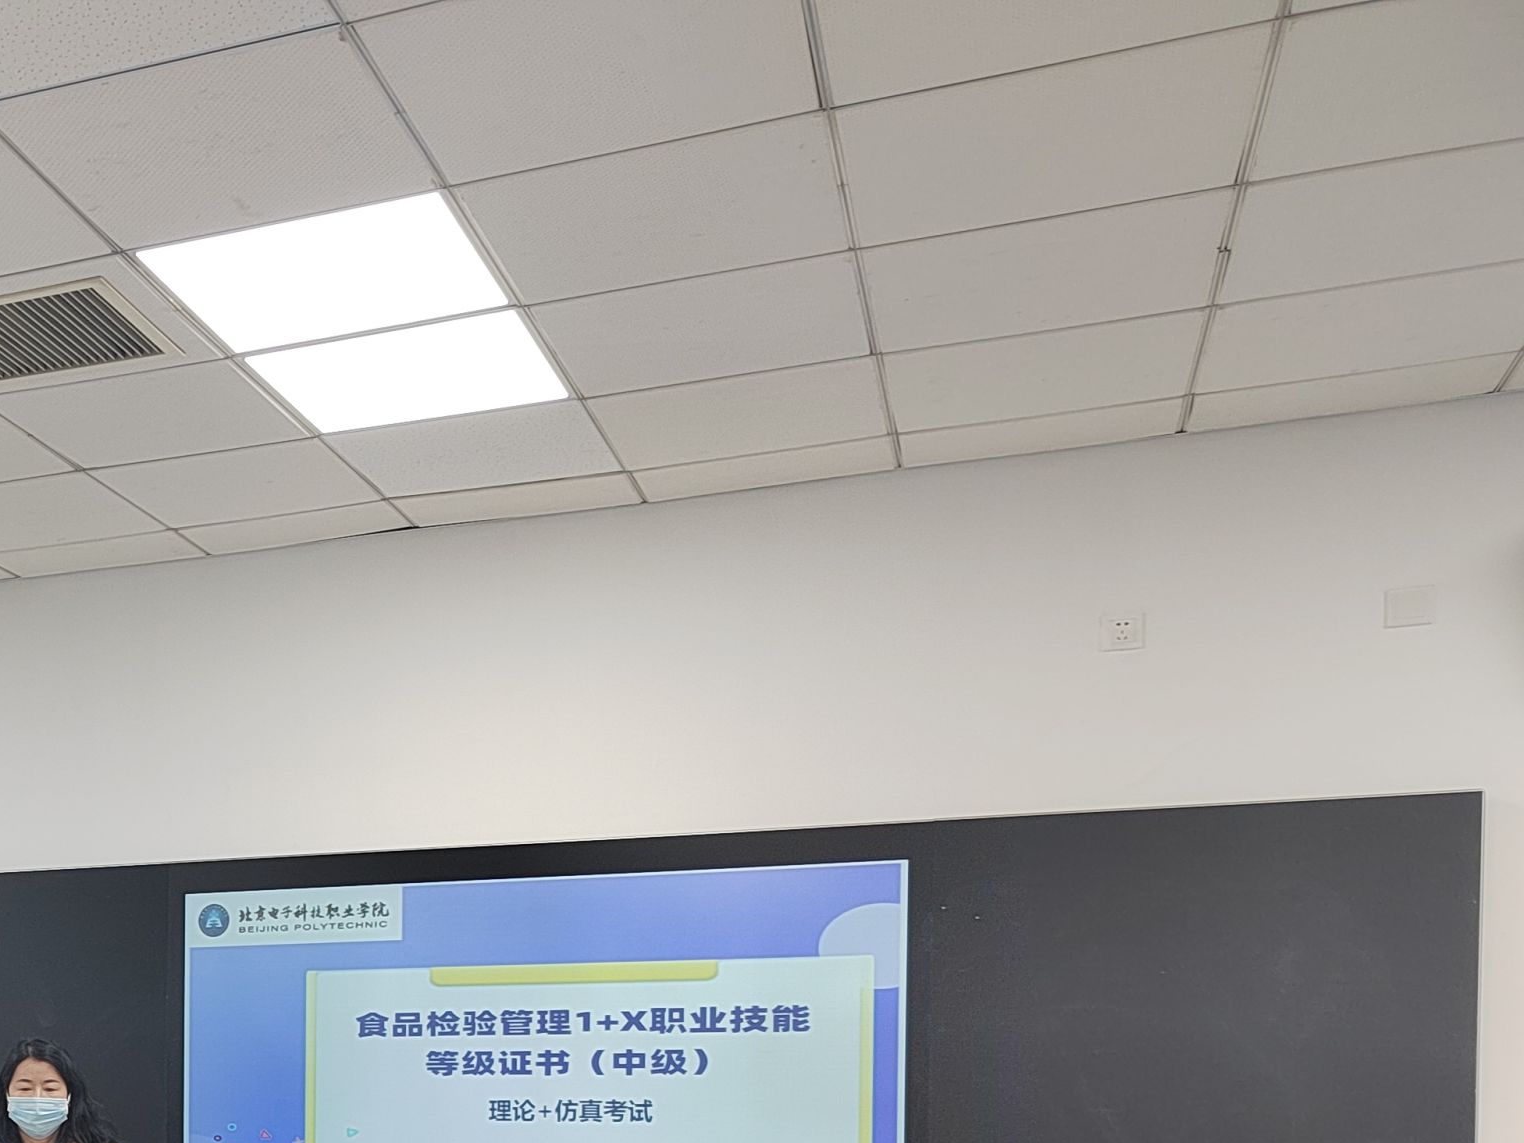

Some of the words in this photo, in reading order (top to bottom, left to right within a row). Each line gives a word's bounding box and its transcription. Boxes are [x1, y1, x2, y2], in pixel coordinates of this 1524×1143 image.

[238, 902, 390, 922] 北京电子科技职业学院
[239, 924, 289, 933] BEIJING
[294, 920, 388, 931] POLYTECHNIC
[355, 1003, 812, 1039] 食品检验管理1+X职业技能
[425, 1047, 711, 1078] 等级证书（中级）
[488, 1099, 654, 1124] 理论+仿真考试
